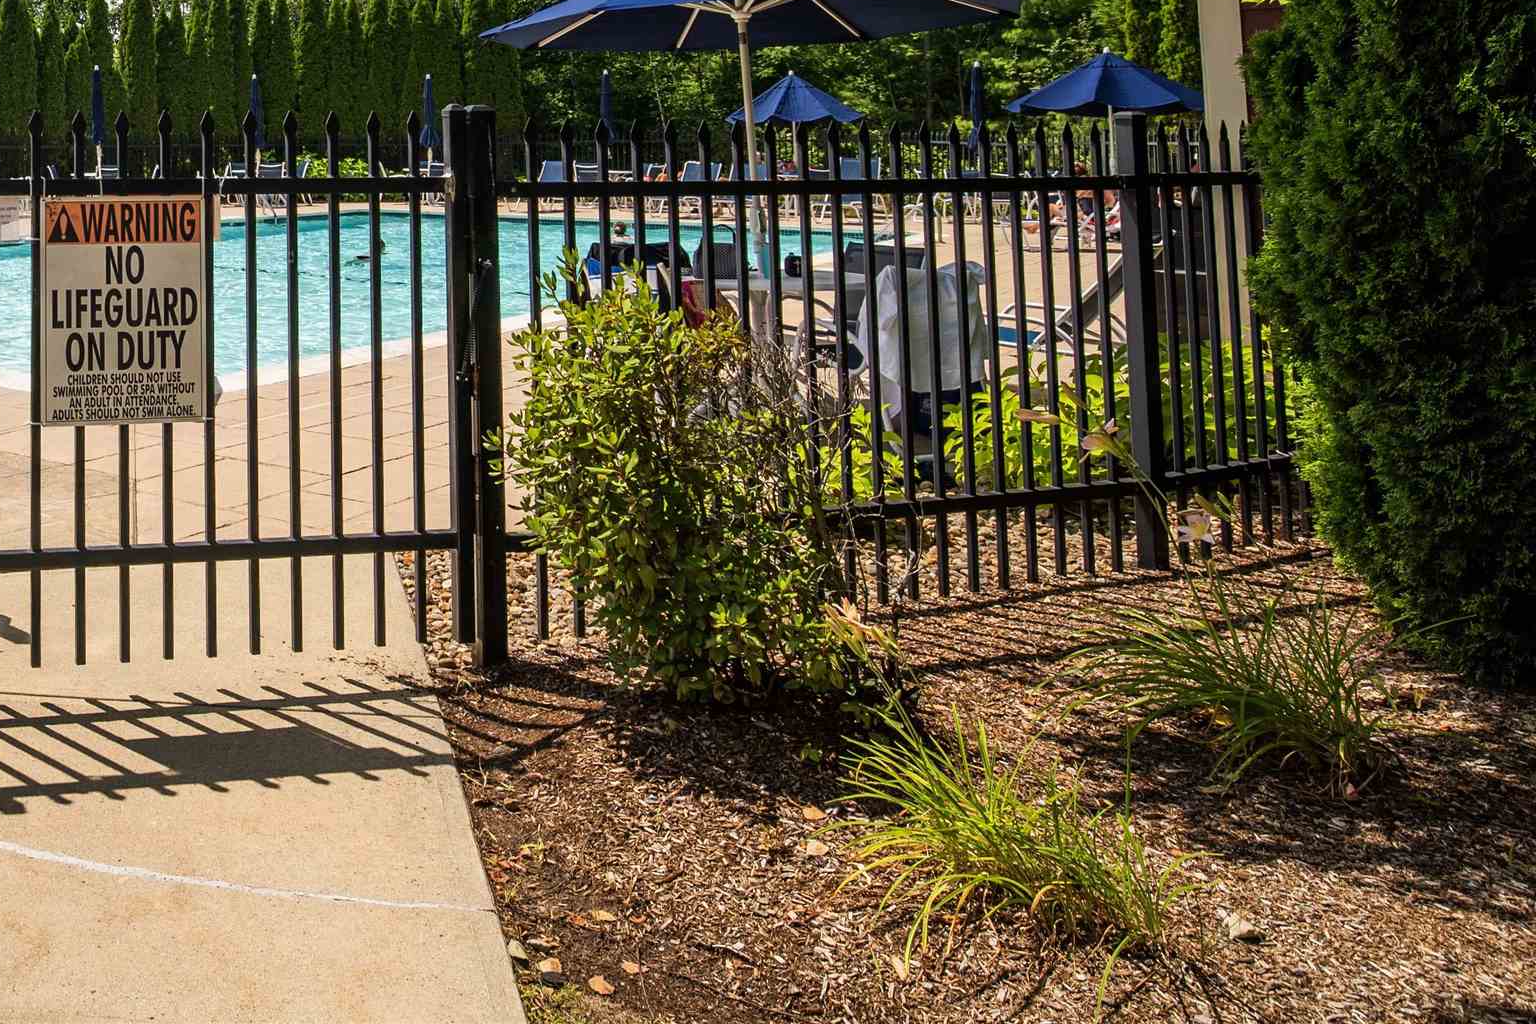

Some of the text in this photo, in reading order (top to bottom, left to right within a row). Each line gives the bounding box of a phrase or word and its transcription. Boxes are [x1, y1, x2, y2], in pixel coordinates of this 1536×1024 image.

[80, 202, 196, 242] WARNING
[105, 245, 145, 285] NO
[52, 287, 198, 329] LIFEGUARD
[65, 330, 186, 372] ON DUTY
[53, 382, 195, 398] SWIMMING POOL OR SPA WITHOUT
[67, 371, 181, 386] CHILDREN SHOULD NOT USE
[52, 404, 196, 421] ADULTS SHOULD NOT SWIM ALONE.
[69, 397, 81, 408] AN
[84, 396, 111, 408] ADULT
[114, 396, 123, 407] IN
